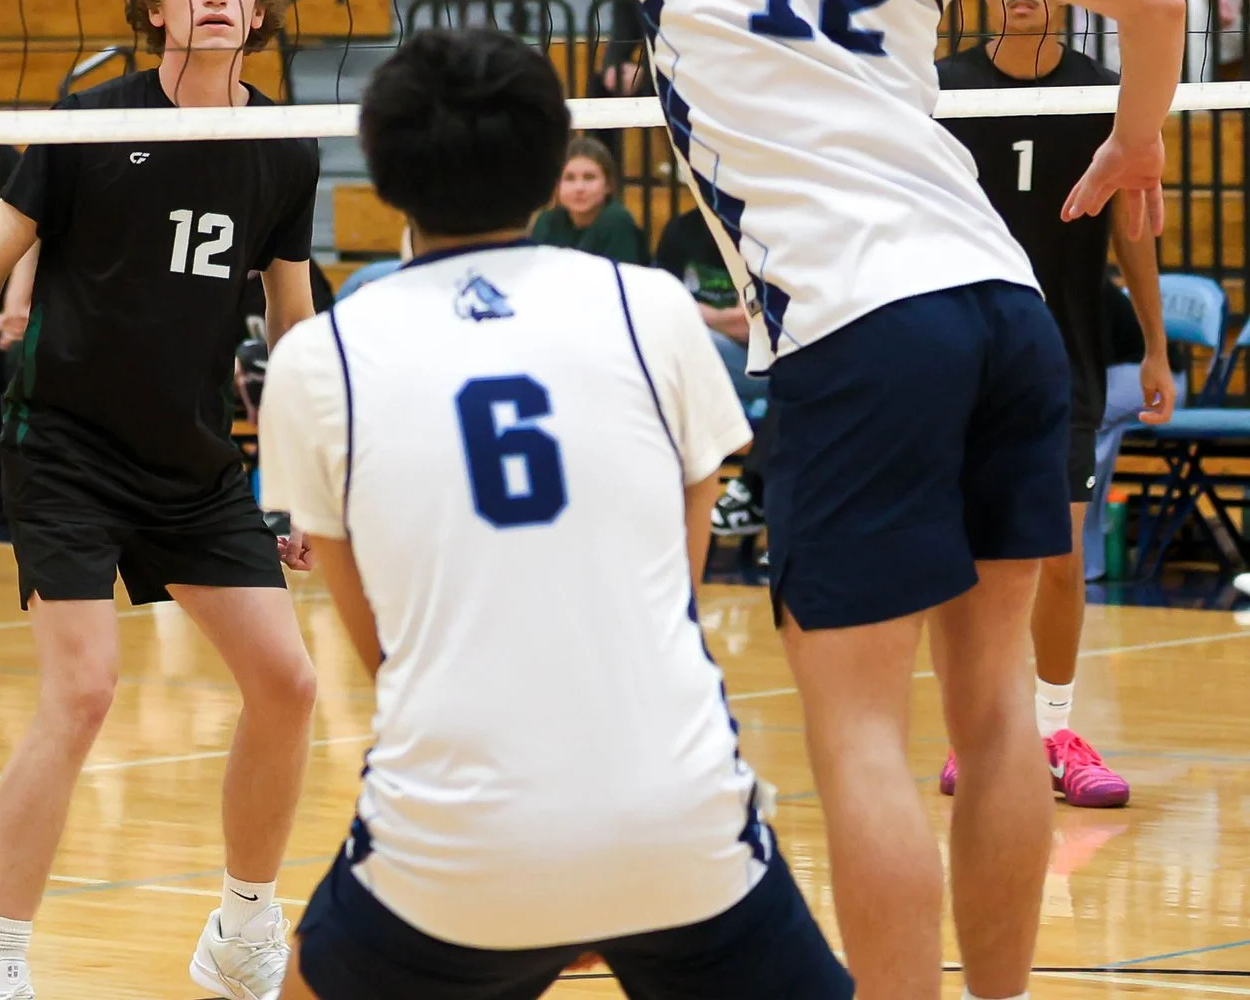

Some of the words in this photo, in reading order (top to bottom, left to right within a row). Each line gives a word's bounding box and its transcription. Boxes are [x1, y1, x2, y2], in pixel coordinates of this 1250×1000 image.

[1012, 140, 1034, 192] 1
[168, 209, 235, 280] 12
[453, 373, 570, 531] 6
